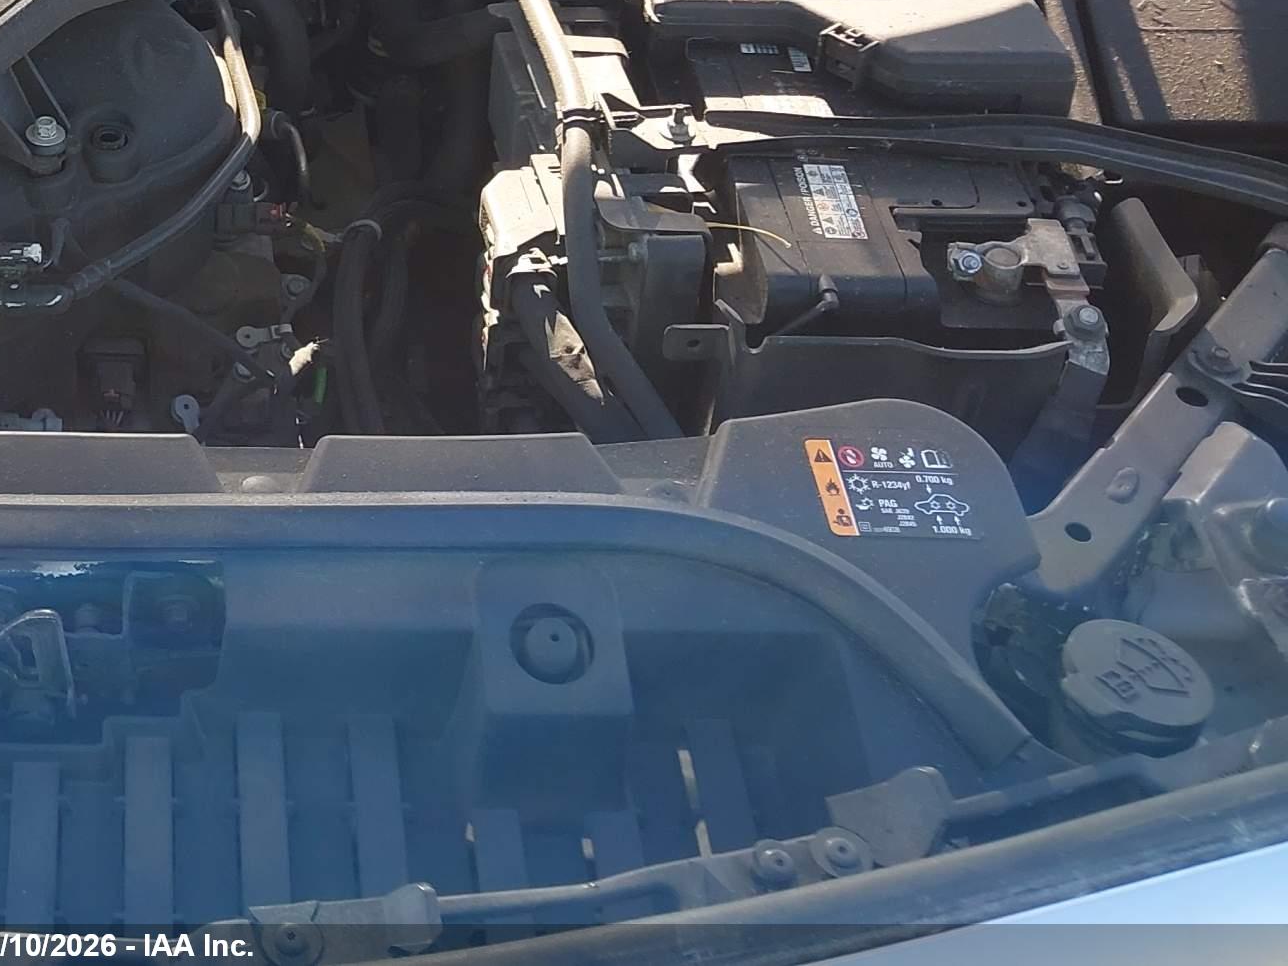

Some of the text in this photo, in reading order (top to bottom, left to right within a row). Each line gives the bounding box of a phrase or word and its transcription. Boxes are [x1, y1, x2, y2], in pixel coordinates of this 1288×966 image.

[802, 197, 821, 227] DANGER
[873, 461, 894, 469] AUTO
[871, 480, 911, 491] R-1234yf
[915, 475, 954, 486] 0.700 kg
[878, 499, 899, 508] PAG
[932, 525, 972, 536] 1.000 kg
